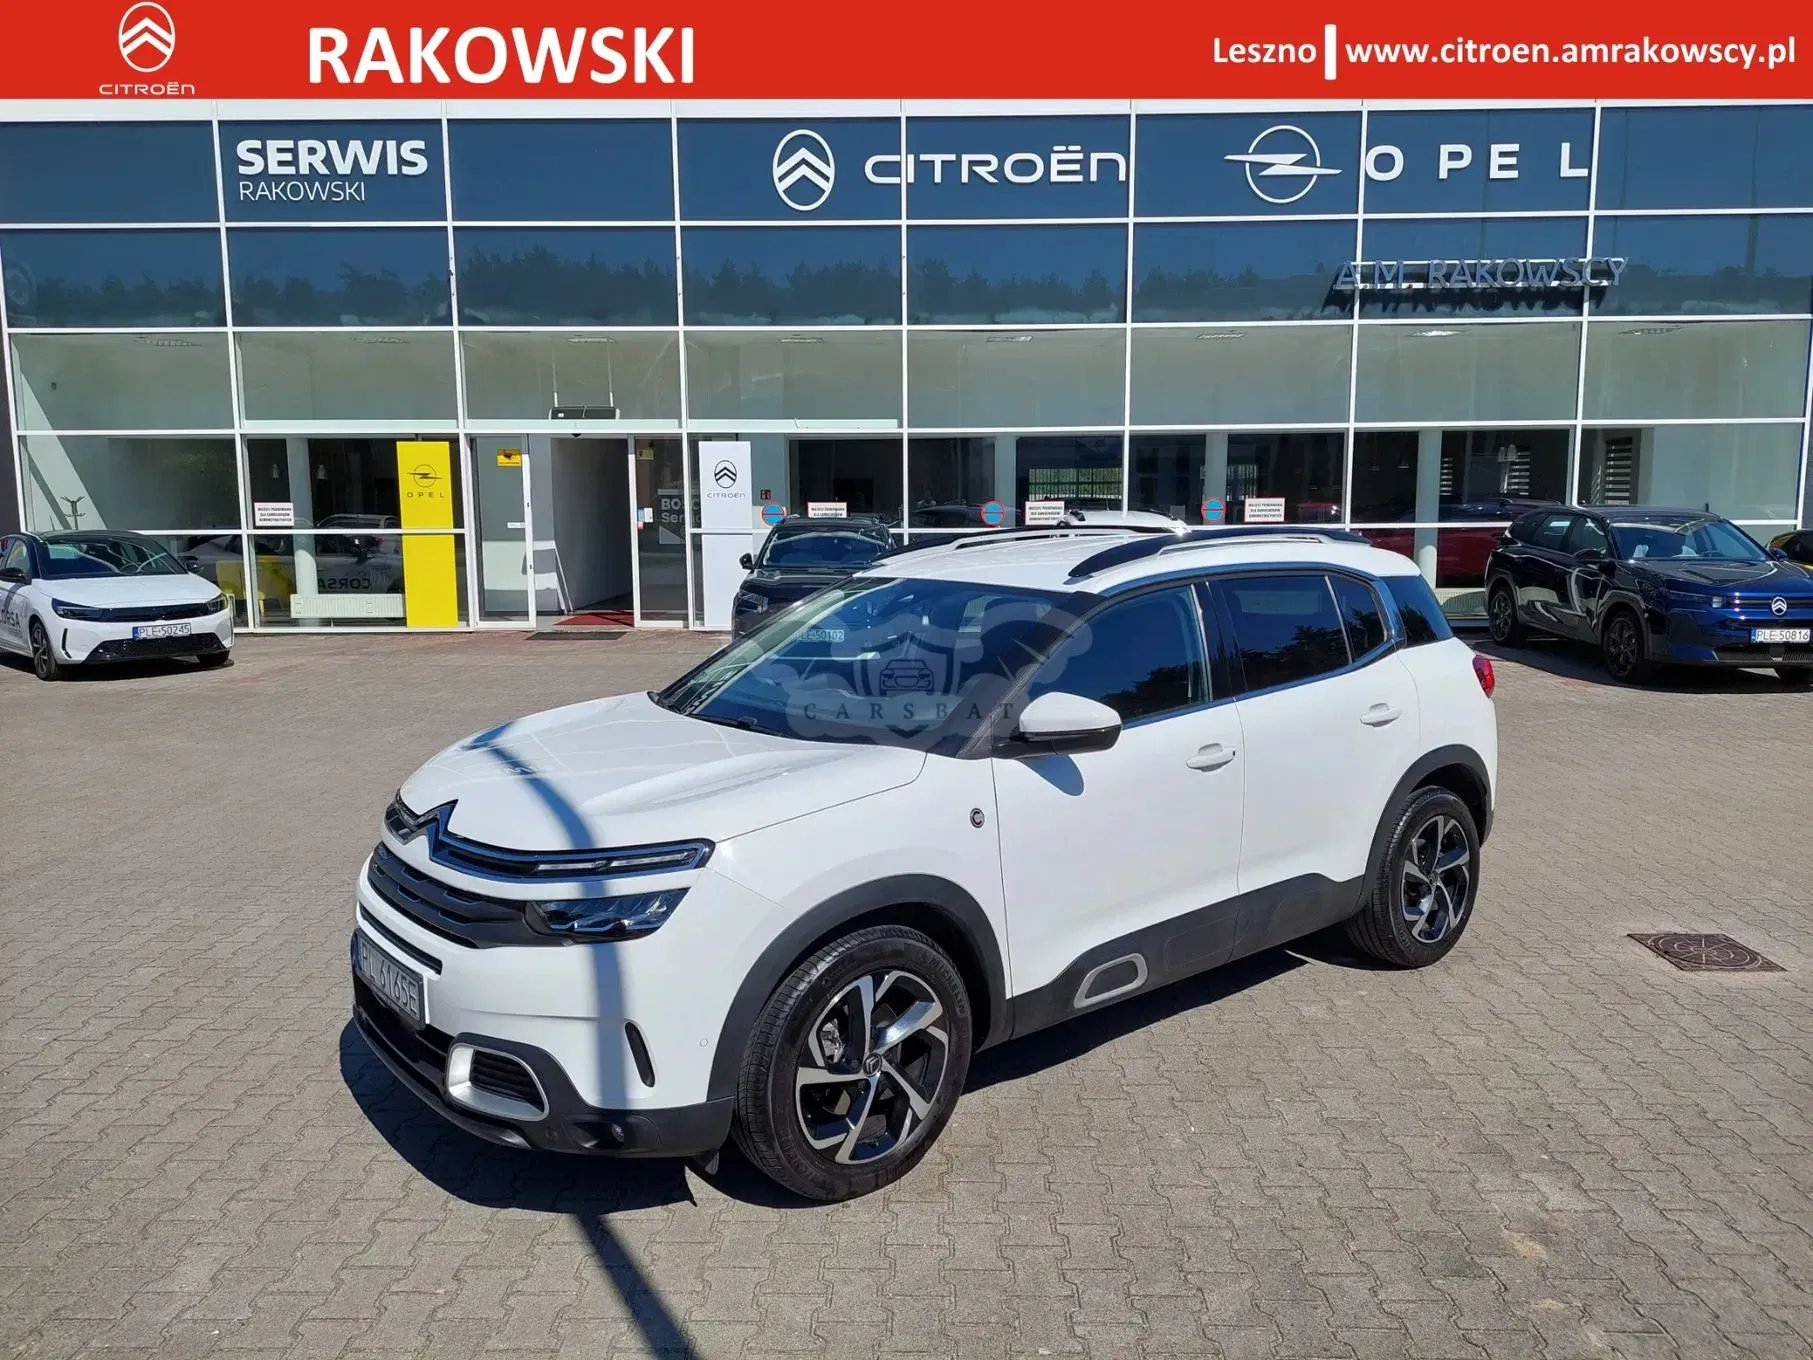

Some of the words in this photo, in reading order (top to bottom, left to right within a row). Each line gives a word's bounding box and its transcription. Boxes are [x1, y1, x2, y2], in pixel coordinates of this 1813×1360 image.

[236, 139, 428, 176] SERWIS
[1365, 142, 1589, 181] OPEL
[239, 181, 365, 201] RAKOWSKI
[1427, 257, 1629, 289] RAKOWSCY
[406, 491, 444, 499] OPEL
[160, 624, 190, 636] 50245
[1779, 630, 1809, 641] 50816
